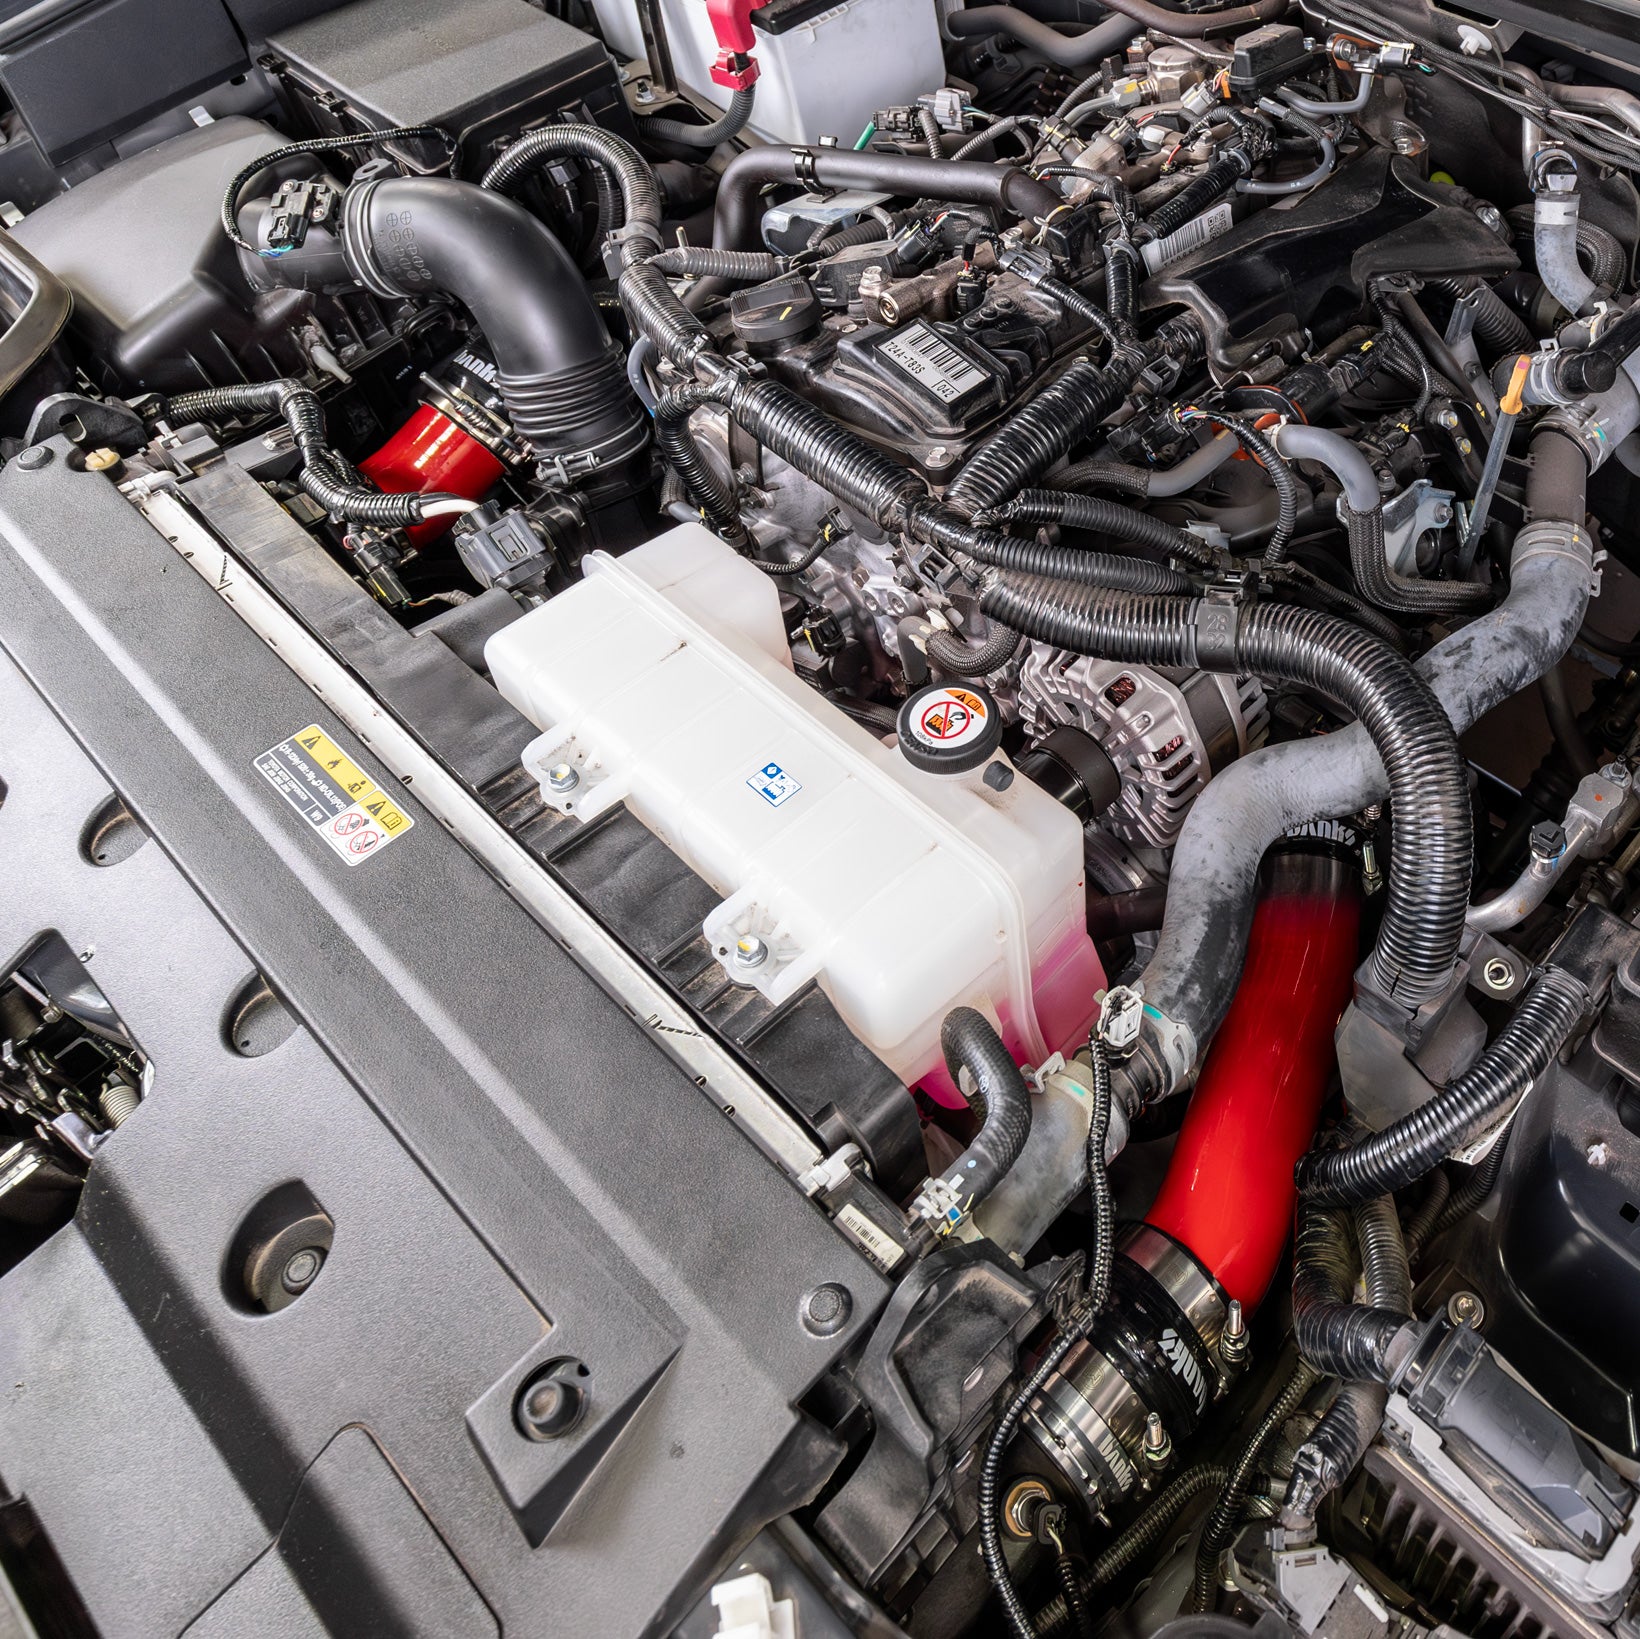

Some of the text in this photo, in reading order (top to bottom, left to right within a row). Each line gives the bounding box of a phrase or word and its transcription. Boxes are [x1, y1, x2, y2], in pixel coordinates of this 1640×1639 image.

[885, 341, 925, 374] T24A-T83S
[936, 383, 954, 398] 042
[915, 730, 933, 745] 108kPa
[287, 780, 309, 801] CORPORATION
